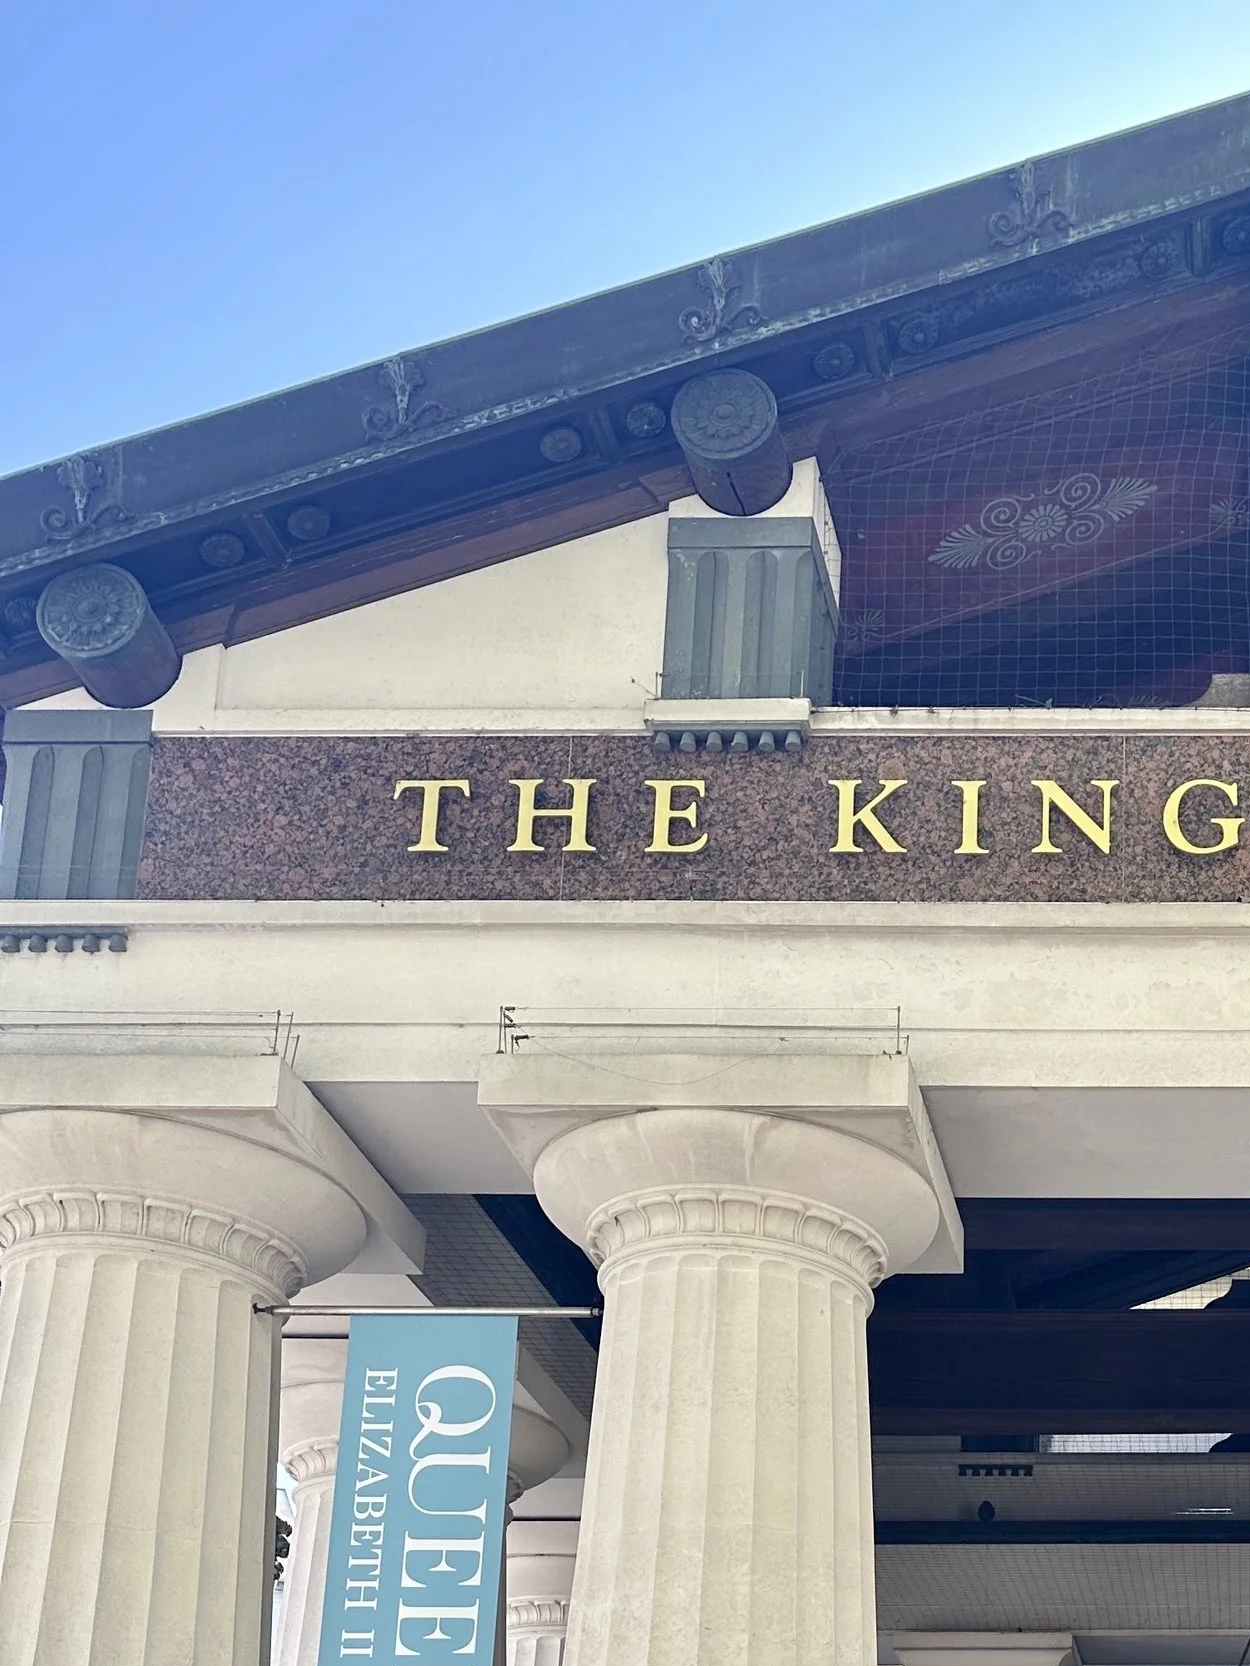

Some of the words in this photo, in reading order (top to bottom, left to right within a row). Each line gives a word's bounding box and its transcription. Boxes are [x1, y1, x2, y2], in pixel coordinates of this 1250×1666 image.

[394, 778, 711, 854] THE
[344, 1367, 399, 1612] ELIZABETH
[339, 1629, 376, 1659] II
